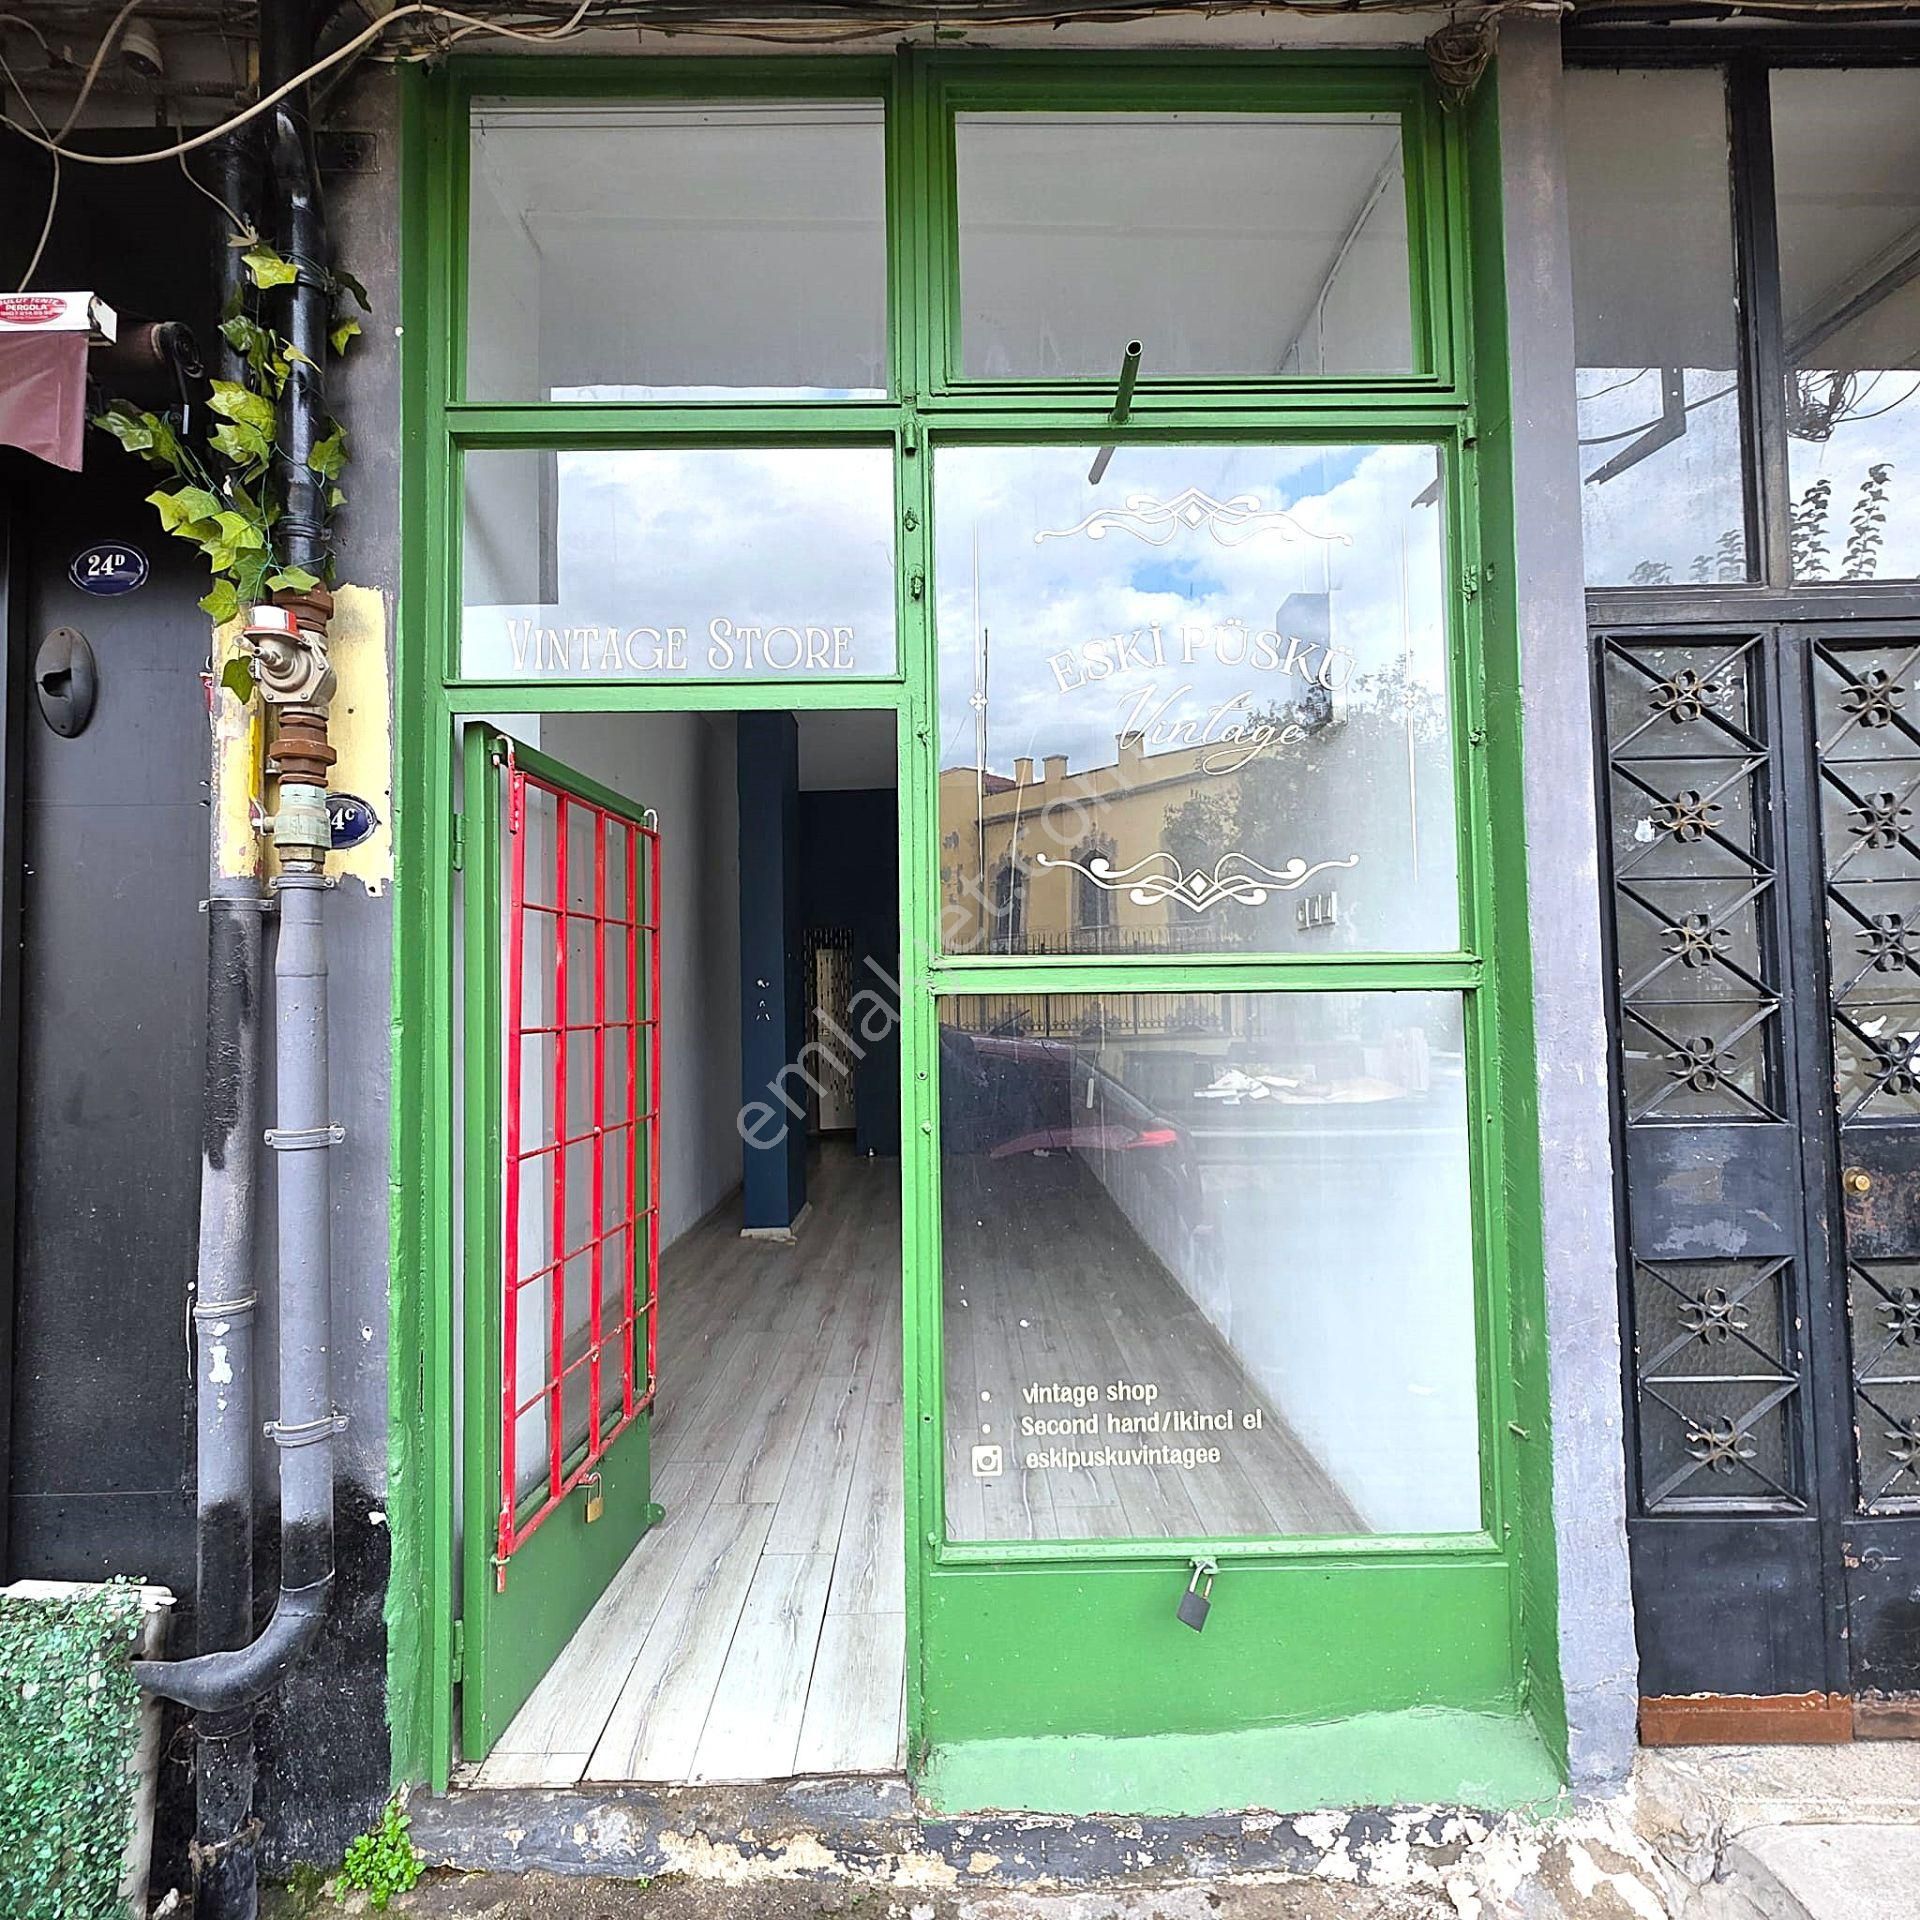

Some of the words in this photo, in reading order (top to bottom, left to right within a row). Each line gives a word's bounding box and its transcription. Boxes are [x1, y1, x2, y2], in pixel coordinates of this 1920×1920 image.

[1046, 620, 1167, 694] ESKİ
[1180, 617, 1357, 691] PÜSKÜ
[1115, 684, 1305, 776] Vintage
[1022, 1382, 1099, 1408] vintage
[1106, 1380, 1158, 1405] shop
[1020, 1413, 1099, 1436] Second
[1241, 1408, 1263, 1430] el
[1025, 1444, 1221, 1471] eskipuskuvintagee
